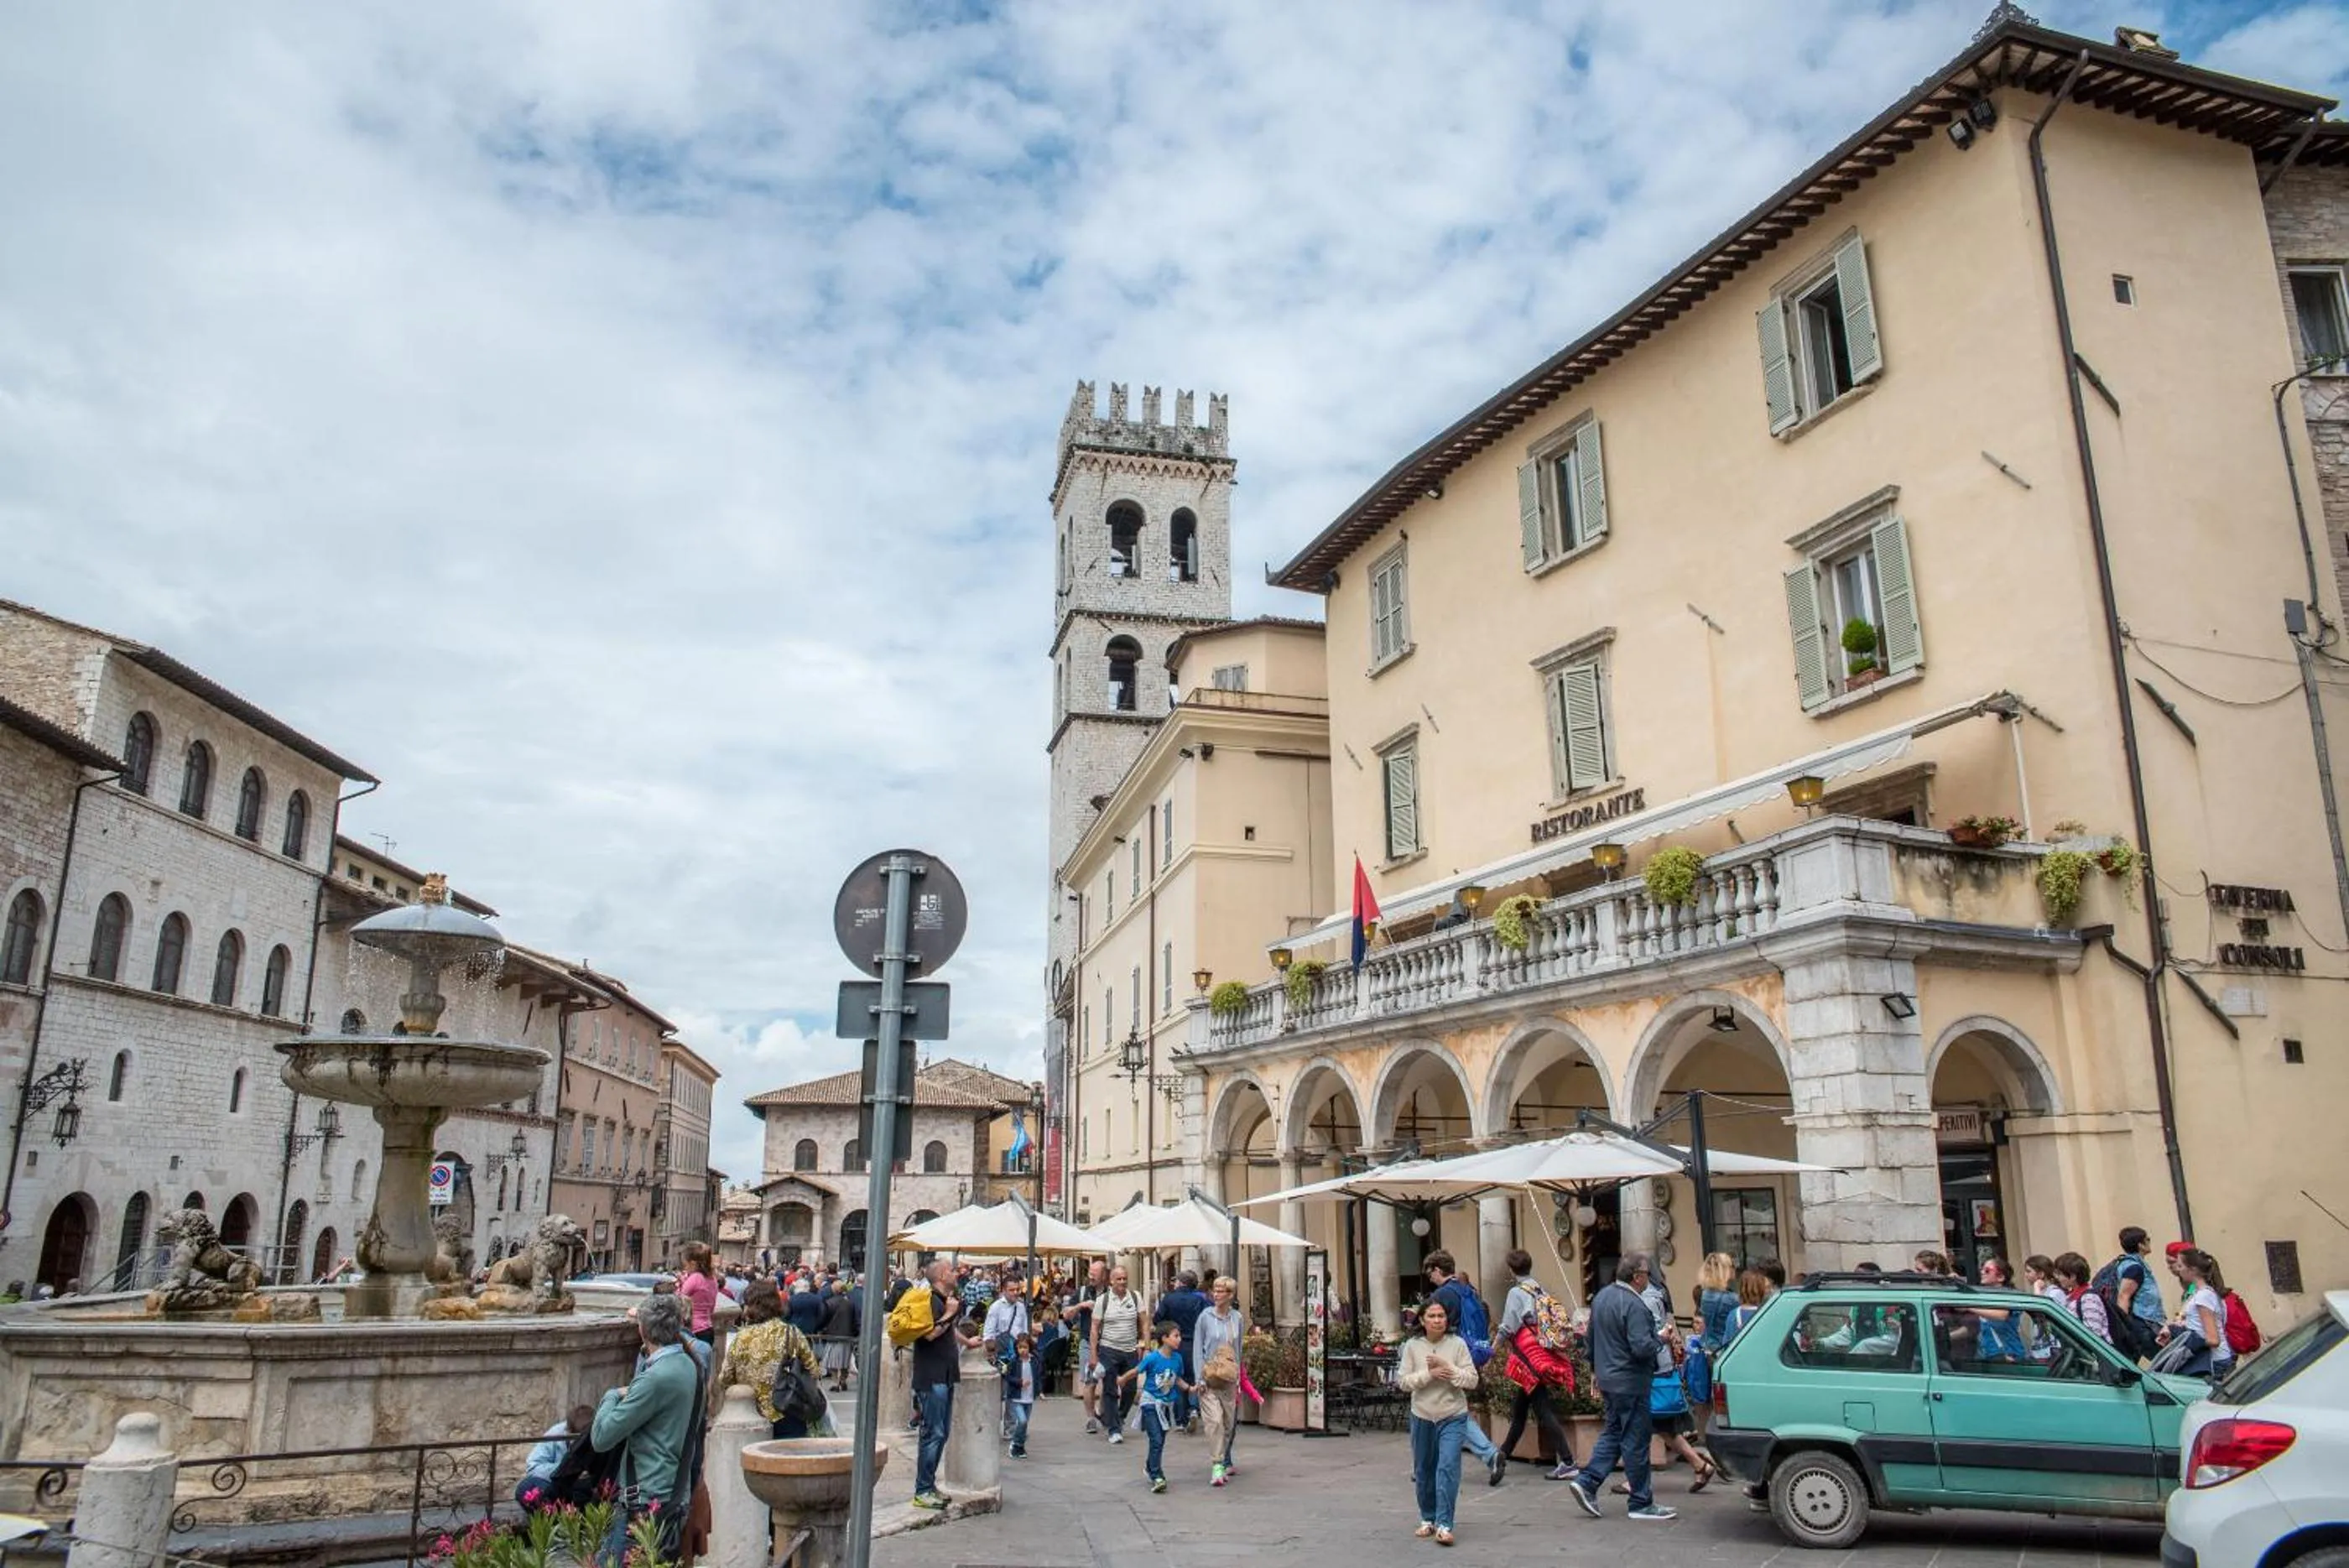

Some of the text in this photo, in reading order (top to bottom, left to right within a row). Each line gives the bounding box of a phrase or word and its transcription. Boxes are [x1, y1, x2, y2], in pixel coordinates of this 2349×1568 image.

[1529, 788, 1645, 842] RISTORANTE
[2208, 884, 2296, 912] TAVERNA
[2217, 943, 2305, 970] CONSOLI
